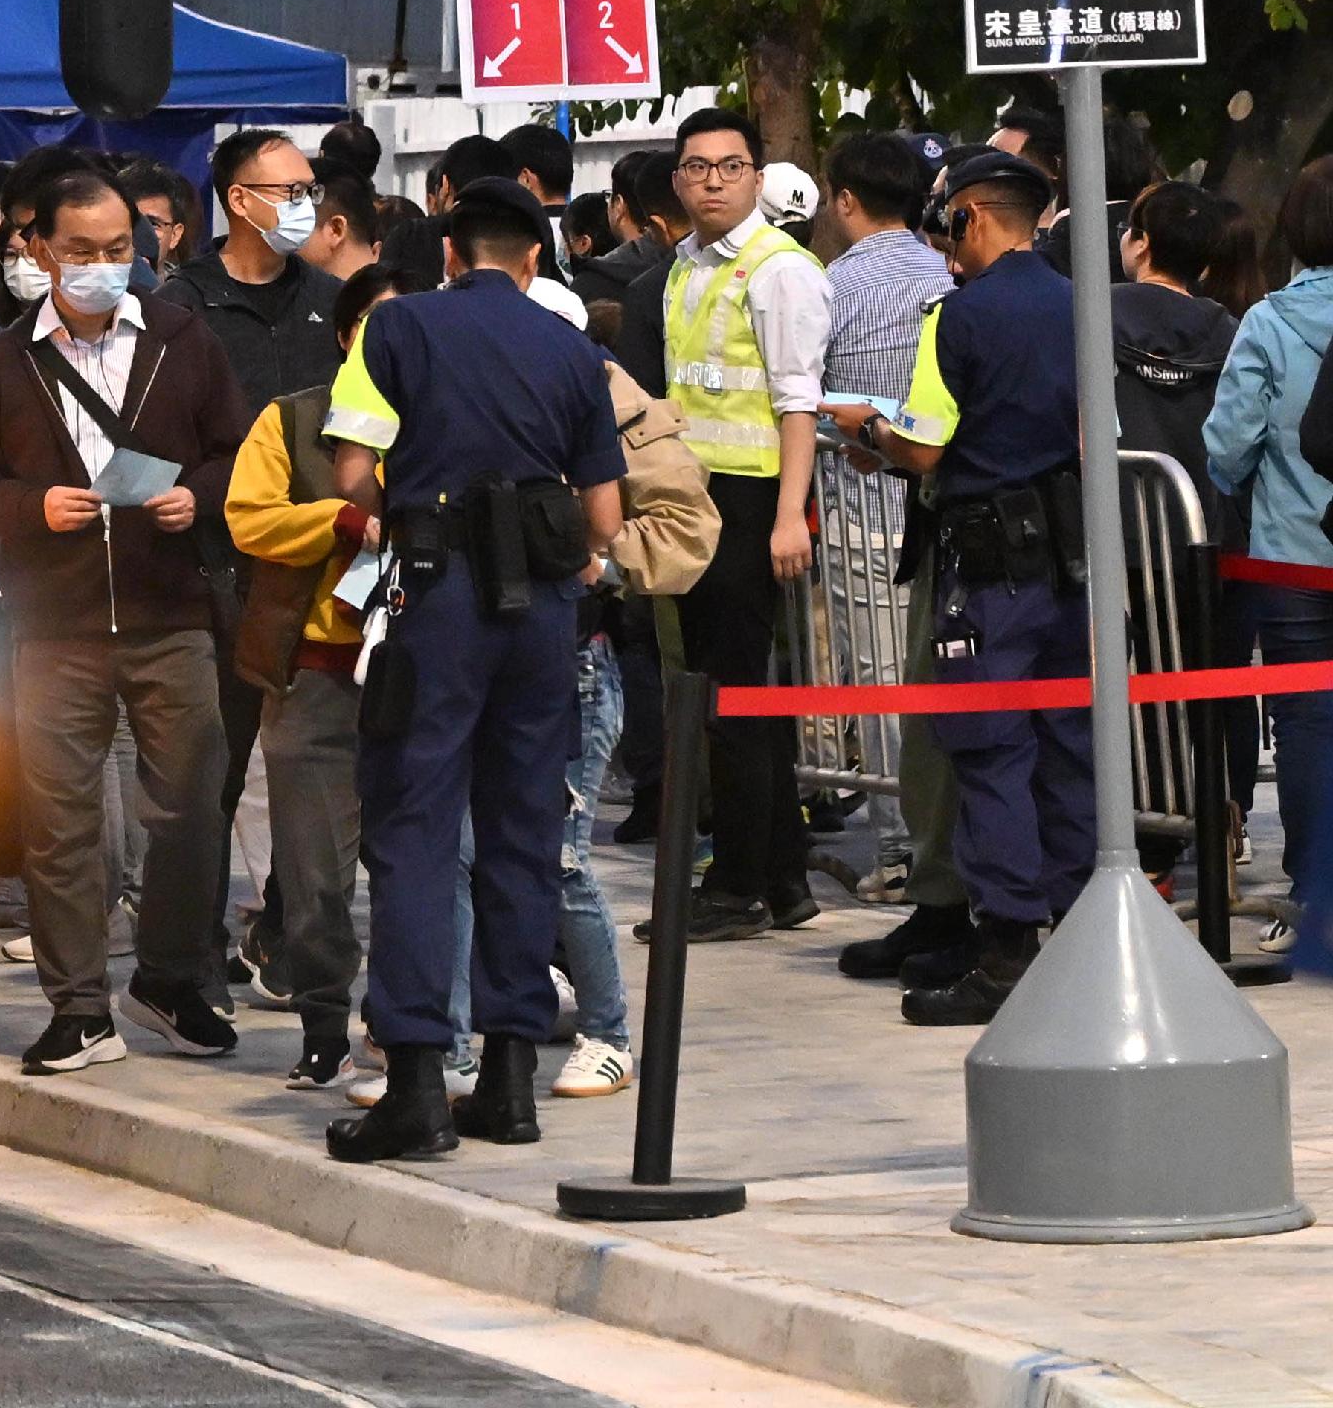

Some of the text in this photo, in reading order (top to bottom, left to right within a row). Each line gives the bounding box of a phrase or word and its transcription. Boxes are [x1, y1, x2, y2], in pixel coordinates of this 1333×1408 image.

[509, 2, 522, 30] 1
[597, 0, 615, 29] 2
[985, 38, 1013, 48] SUNG
[1015, 36, 1046, 46] WONG
[1065, 34, 1093, 45] ROAD
